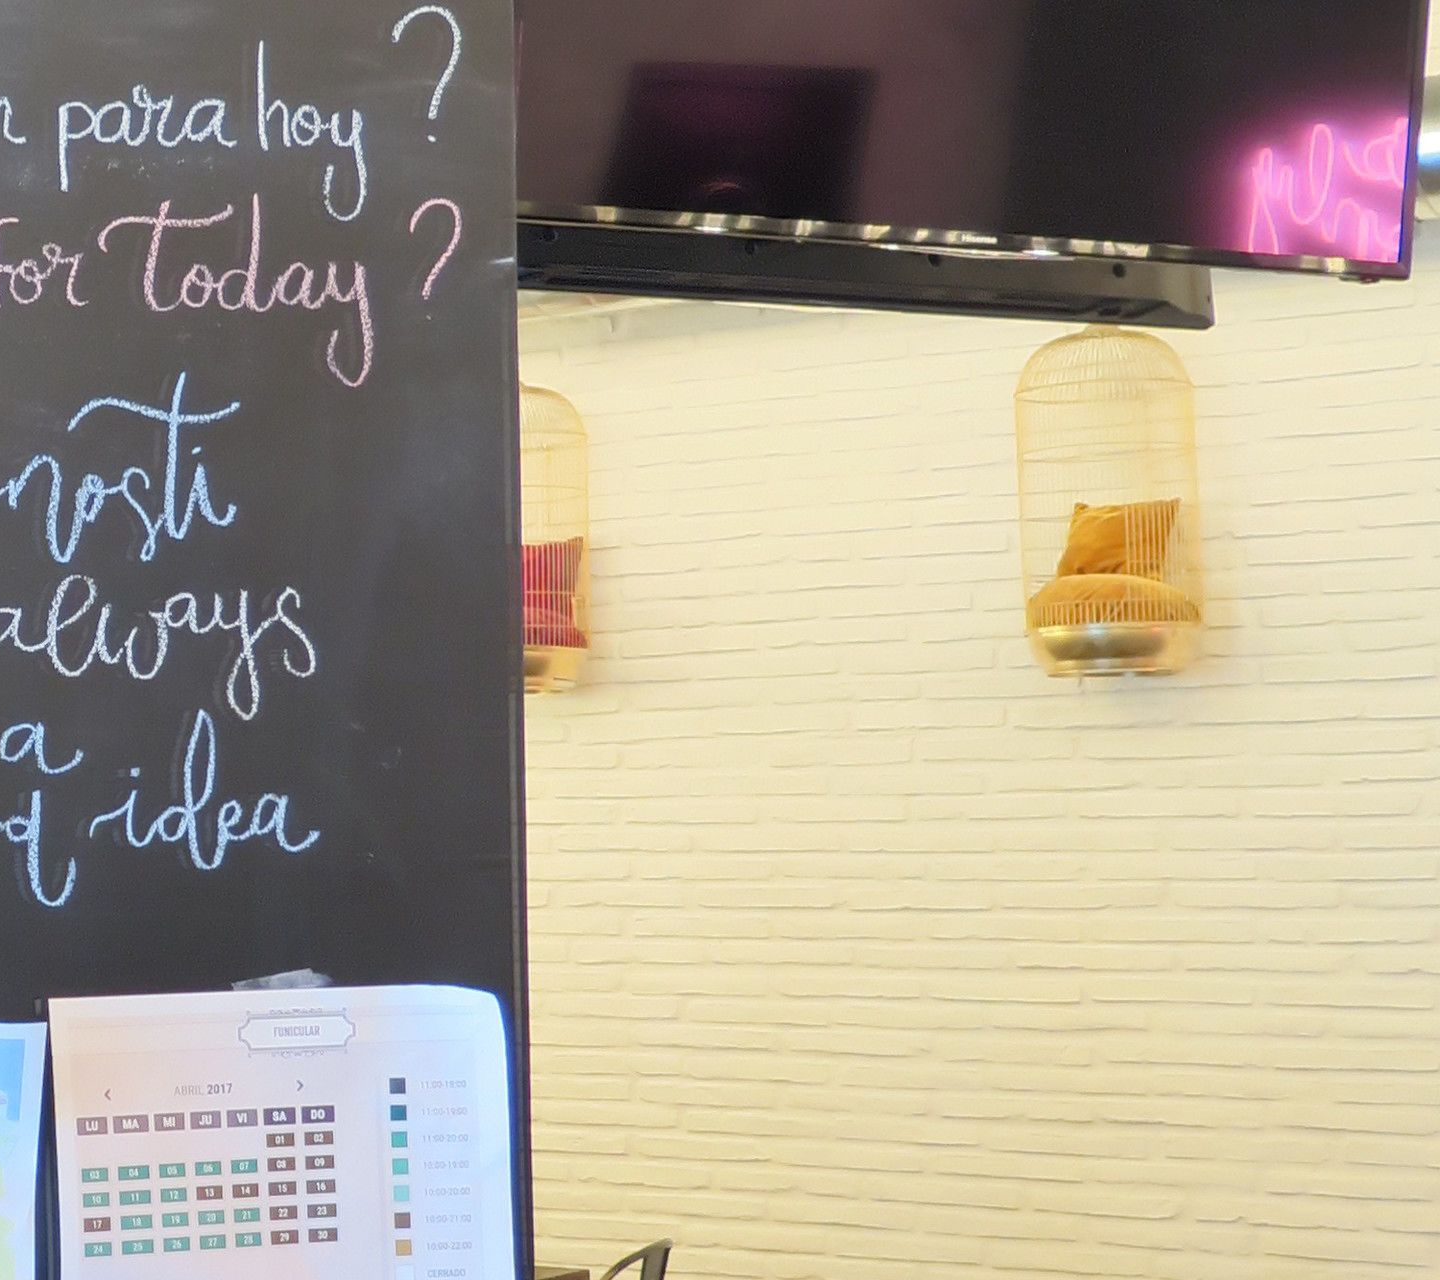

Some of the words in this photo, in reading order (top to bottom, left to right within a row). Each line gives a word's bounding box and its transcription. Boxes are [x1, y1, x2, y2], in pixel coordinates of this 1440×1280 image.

[58, 84, 237, 192] para
[256, 39, 367, 221] hoy
[392, 5, 462, 143] ?
[961, 232, 998, 244] Hisense
[410, 198, 464, 322] ?
[0, 722, 84, 775] a
[89, 708, 321, 871] idea
[273, 1025, 321, 1038] FUNICULAR
[174, 1084, 204, 1096] ABRIL
[207, 1083, 233, 1095] 2017
[85, 1120, 98, 1132] LU
[122, 1118, 140, 1130] MA
[163, 1116, 176, 1128] MI
[199, 1114, 213, 1126] JU
[236, 1112, 248, 1124] VI
[272, 1110, 287, 1122] SA
[310, 1109, 326, 1120] DO
[275, 1135, 285, 1145] 01
[313, 1133, 324, 1143] 02
[89, 1170, 100, 1180] 03
[128, 1168, 139, 1178] 04
[239, 1161, 249, 1171] 07
[314, 1157, 325, 1167] 09
[91, 1195, 102, 1205] 10
[130, 1193, 140, 1202] 11
[169, 1190, 179, 1200] 12
[204, 1187, 215, 1197] 13
[241, 1185, 251, 1195] 14
[278, 1183, 288, 1193] 15
[315, 1181, 326, 1191] 16
[92, 1220, 102, 1230] 17
[206, 1212, 217, 1222] 20
[241, 1210, 252, 1220] 21
[277, 1208, 289, 1218] 22
[316, 1206, 327, 1216] 23
[92, 1244, 103, 1254] 24
[207, 1237, 218, 1247] 27
[279, 1232, 290, 1242] 29
[317, 1230, 328, 1240] 30
[427, 1268, 466, 1278] CERRADO
